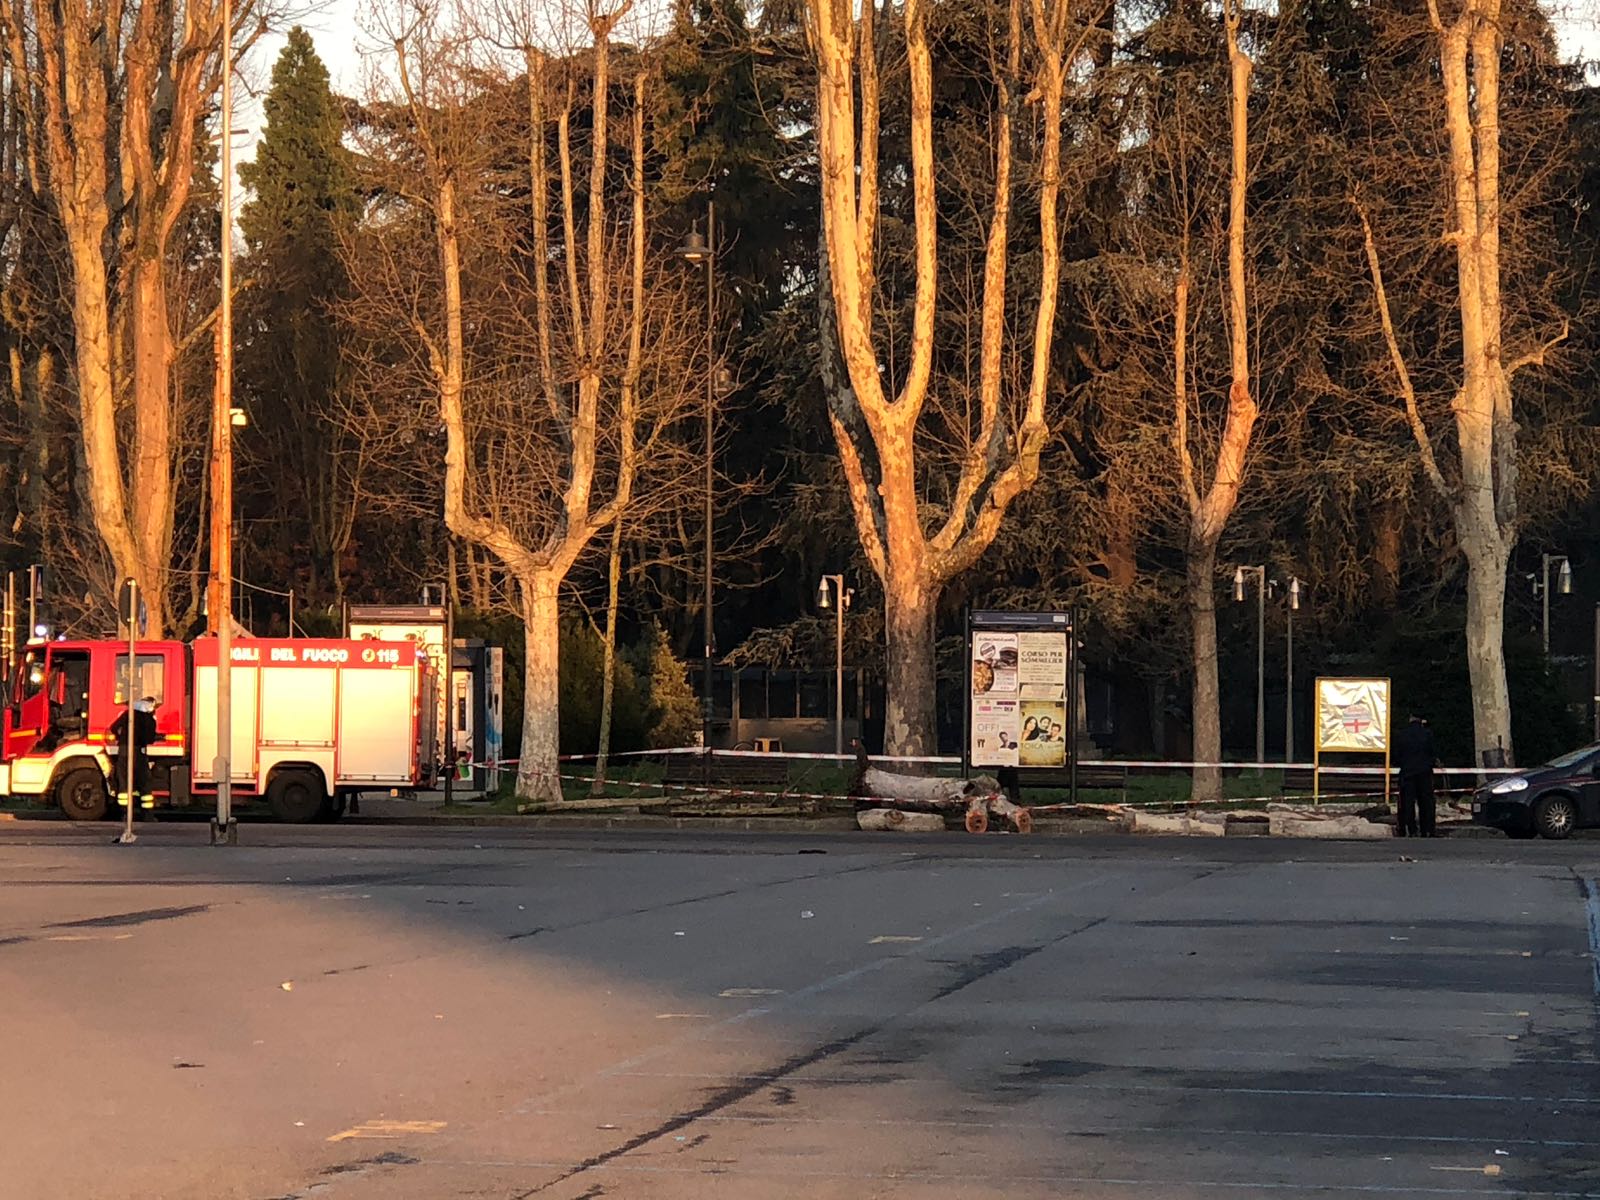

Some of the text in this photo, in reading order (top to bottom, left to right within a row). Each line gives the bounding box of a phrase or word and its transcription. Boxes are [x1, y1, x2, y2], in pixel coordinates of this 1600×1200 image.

[229, 647, 400, 663] IGILI DEL FUOCO 115
